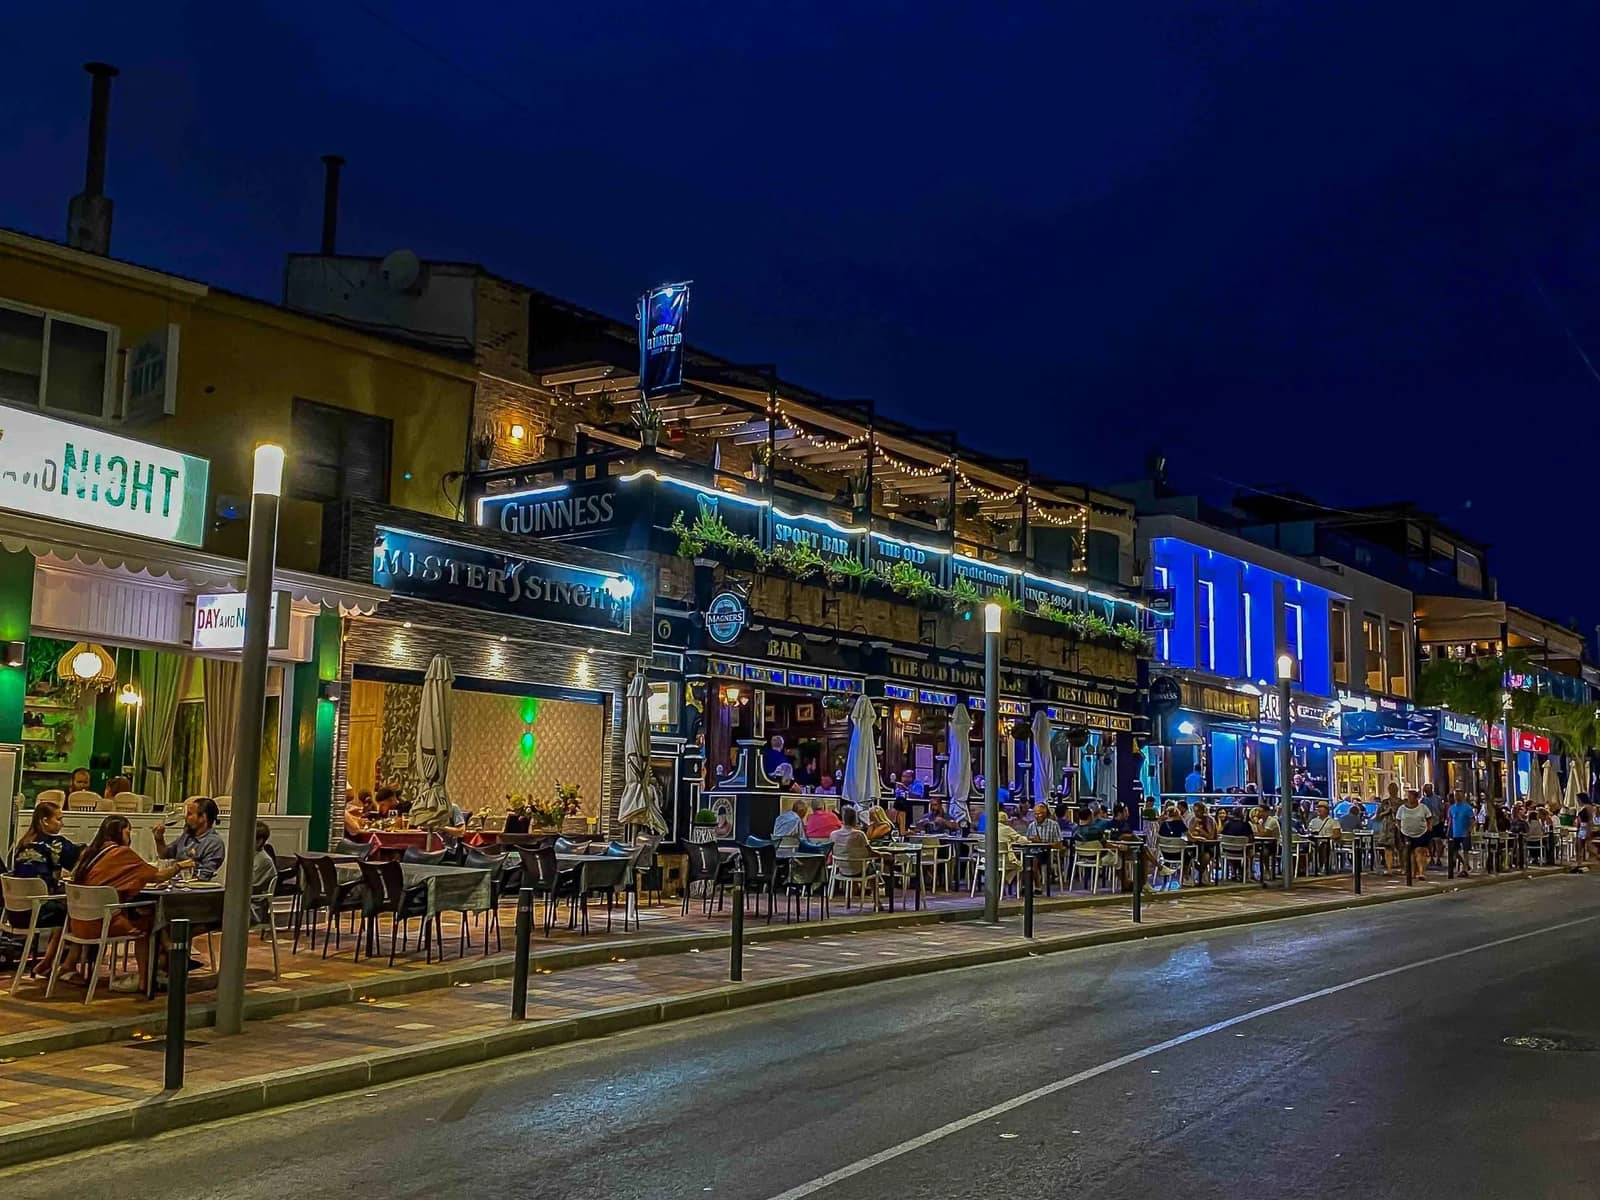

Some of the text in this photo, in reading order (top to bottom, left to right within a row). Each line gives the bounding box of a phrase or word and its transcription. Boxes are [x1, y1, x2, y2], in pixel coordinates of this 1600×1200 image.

[61, 442, 179, 518] NIGHT
[501, 493, 615, 534] GUINNESS
[775, 523, 849, 556] SPORT BAR
[878, 541, 925, 565] THE OLD
[197, 608, 220, 629] DAY
[708, 612, 743, 624] MAGNERS
[767, 639, 802, 660] BAR
[890, 657, 918, 677] THE
[921, 662, 949, 681] OLD
